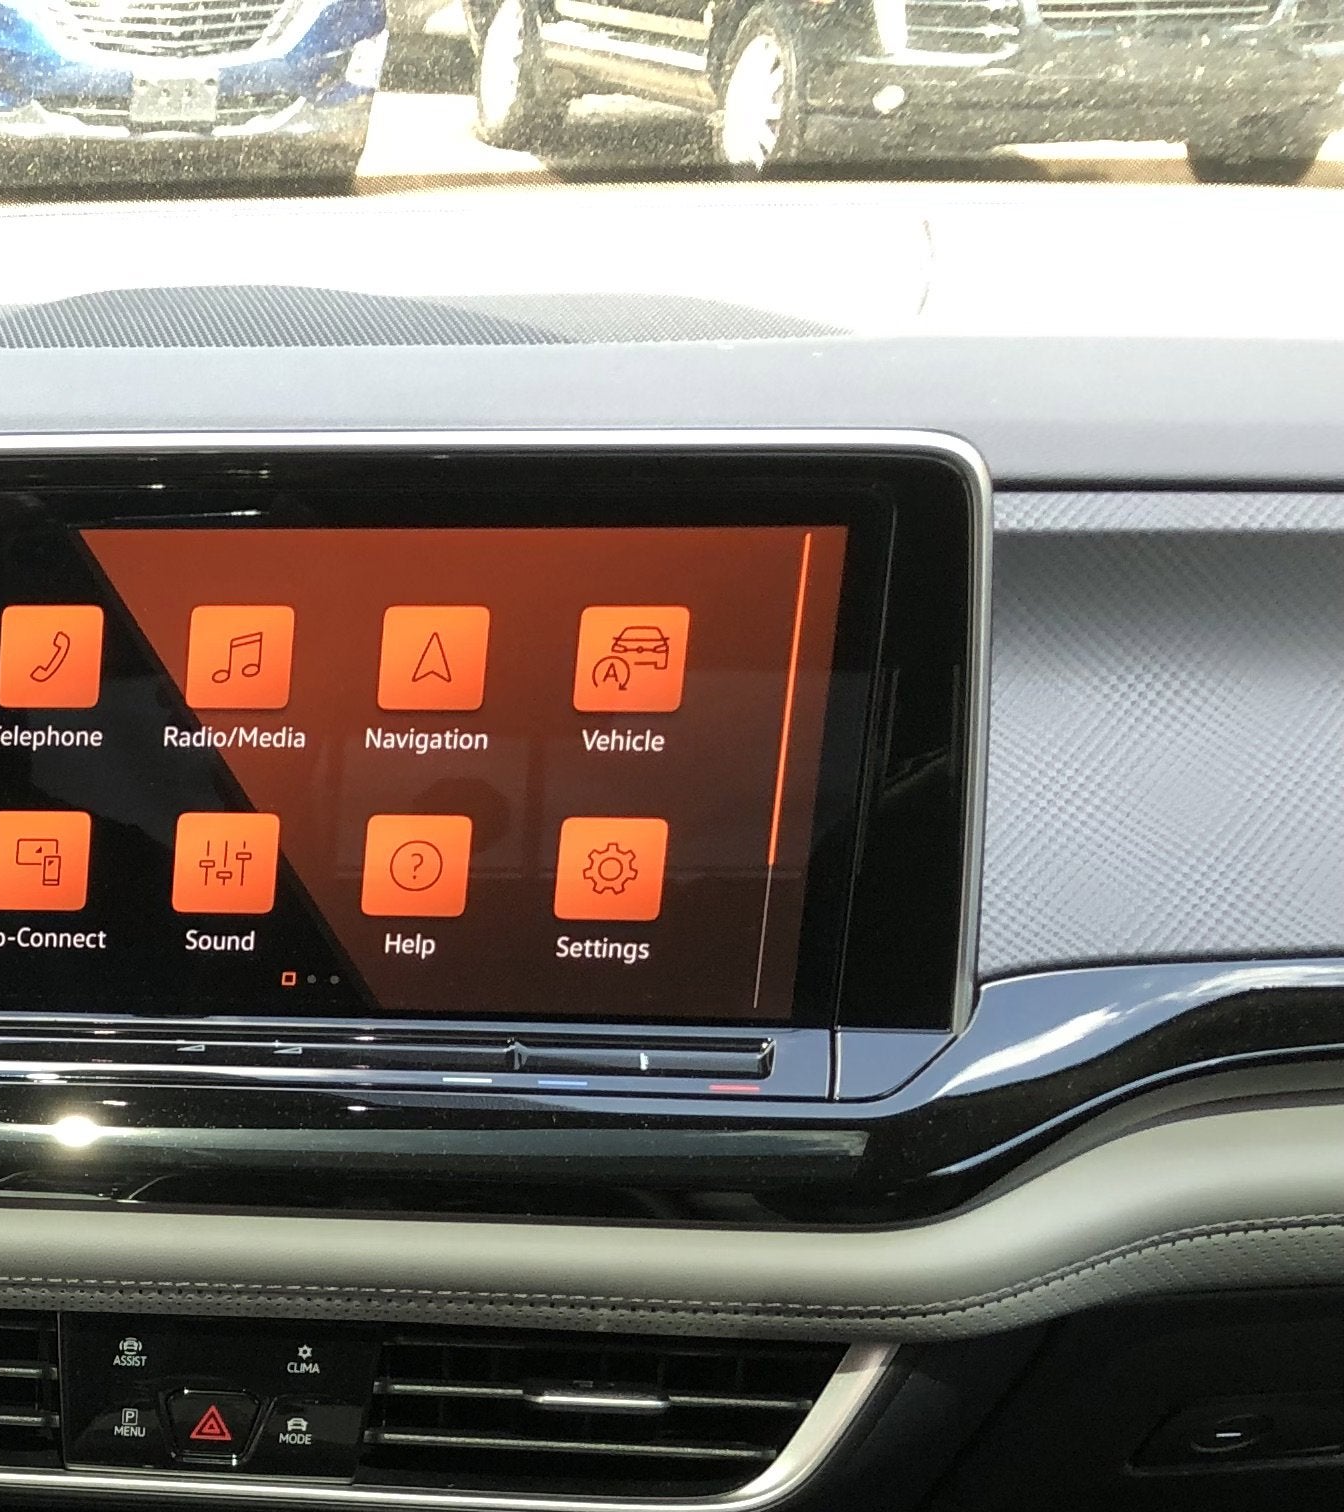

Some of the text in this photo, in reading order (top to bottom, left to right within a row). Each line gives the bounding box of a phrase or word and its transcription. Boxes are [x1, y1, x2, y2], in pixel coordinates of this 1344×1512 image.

[163, 725, 306, 750] Radio/Media
[364, 728, 489, 754] Navigation
[582, 729, 665, 753] Vehicle
[185, 928, 255, 952] Sound
[384, 932, 436, 958] Help
[556, 936, 650, 962] Settings
[113, 1355, 148, 1367] ASSIST
[286, 1362, 320, 1374] CLIMA
[114, 1425, 146, 1437] MENU
[279, 1433, 312, 1445] MODE
